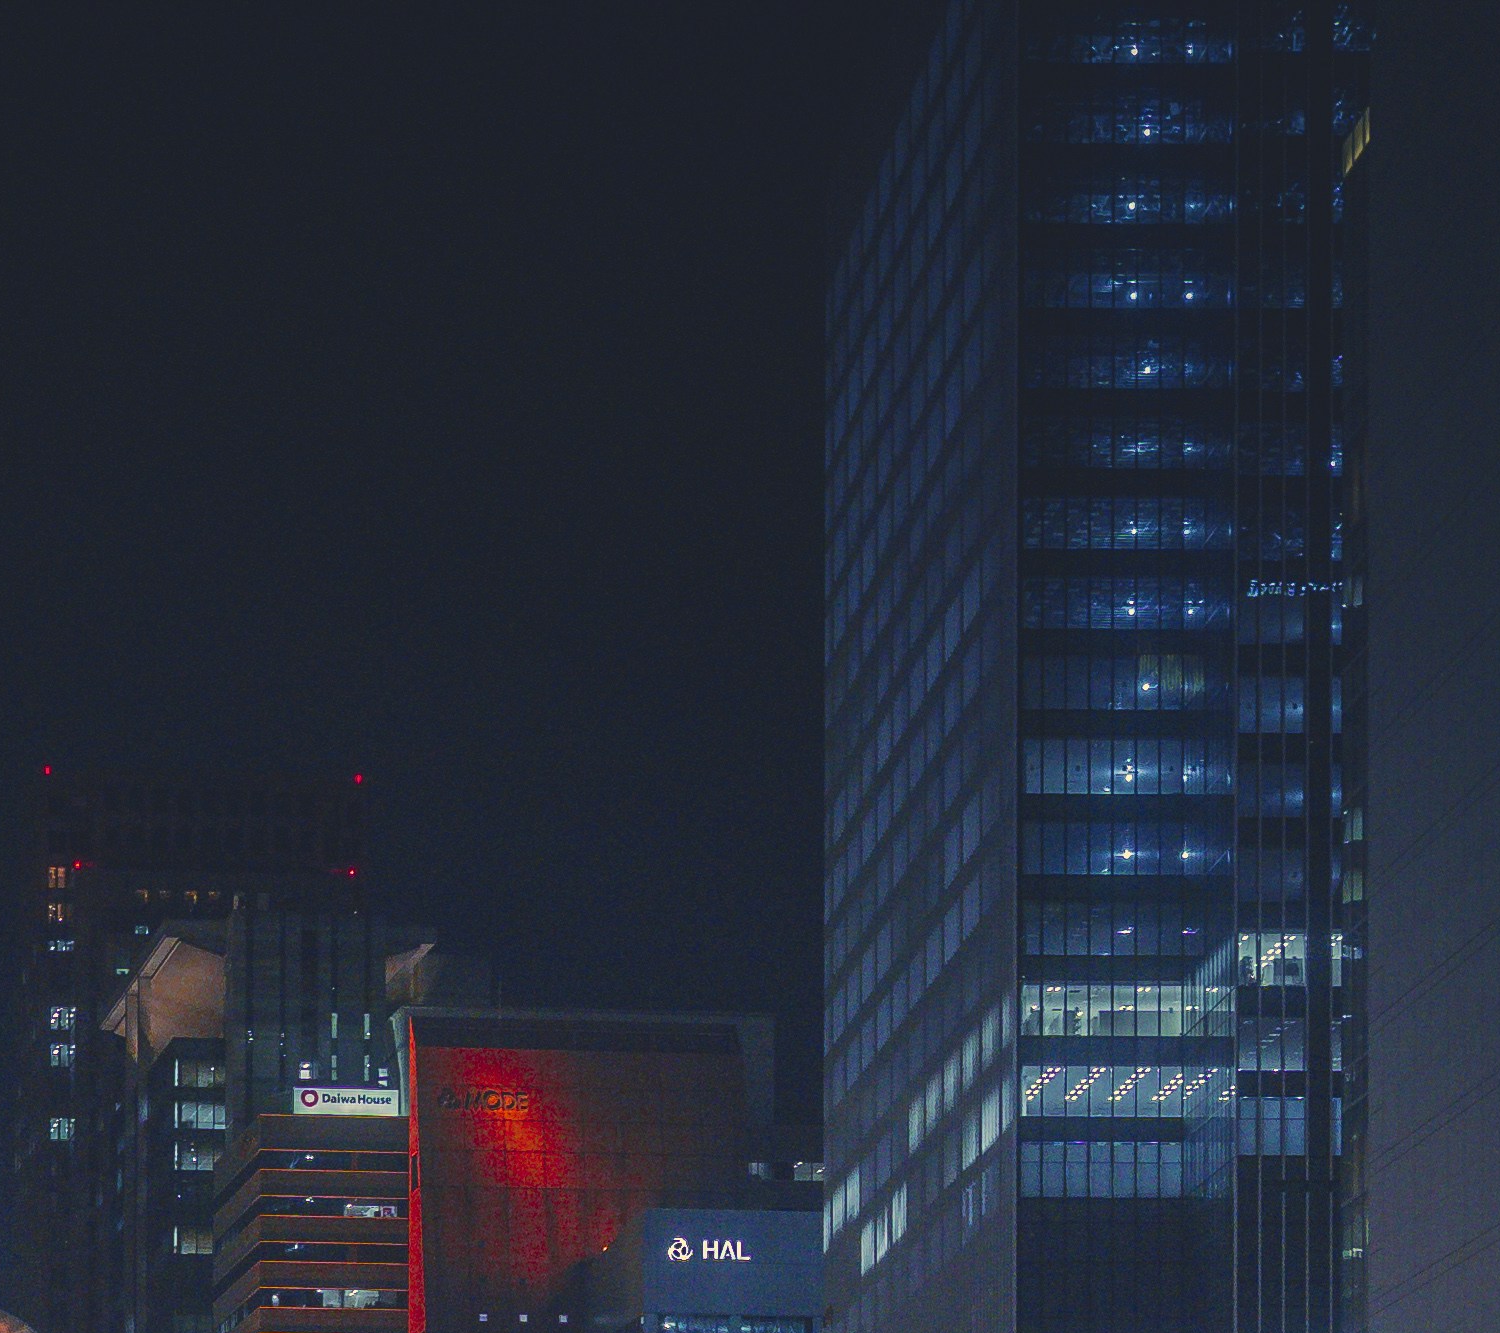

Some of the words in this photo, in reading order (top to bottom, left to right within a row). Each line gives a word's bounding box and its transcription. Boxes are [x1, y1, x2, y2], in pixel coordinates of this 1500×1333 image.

[322, 1093, 356, 1105] Daiwa
[358, 1093, 392, 1105] House
[703, 1239, 751, 1261] HAL
